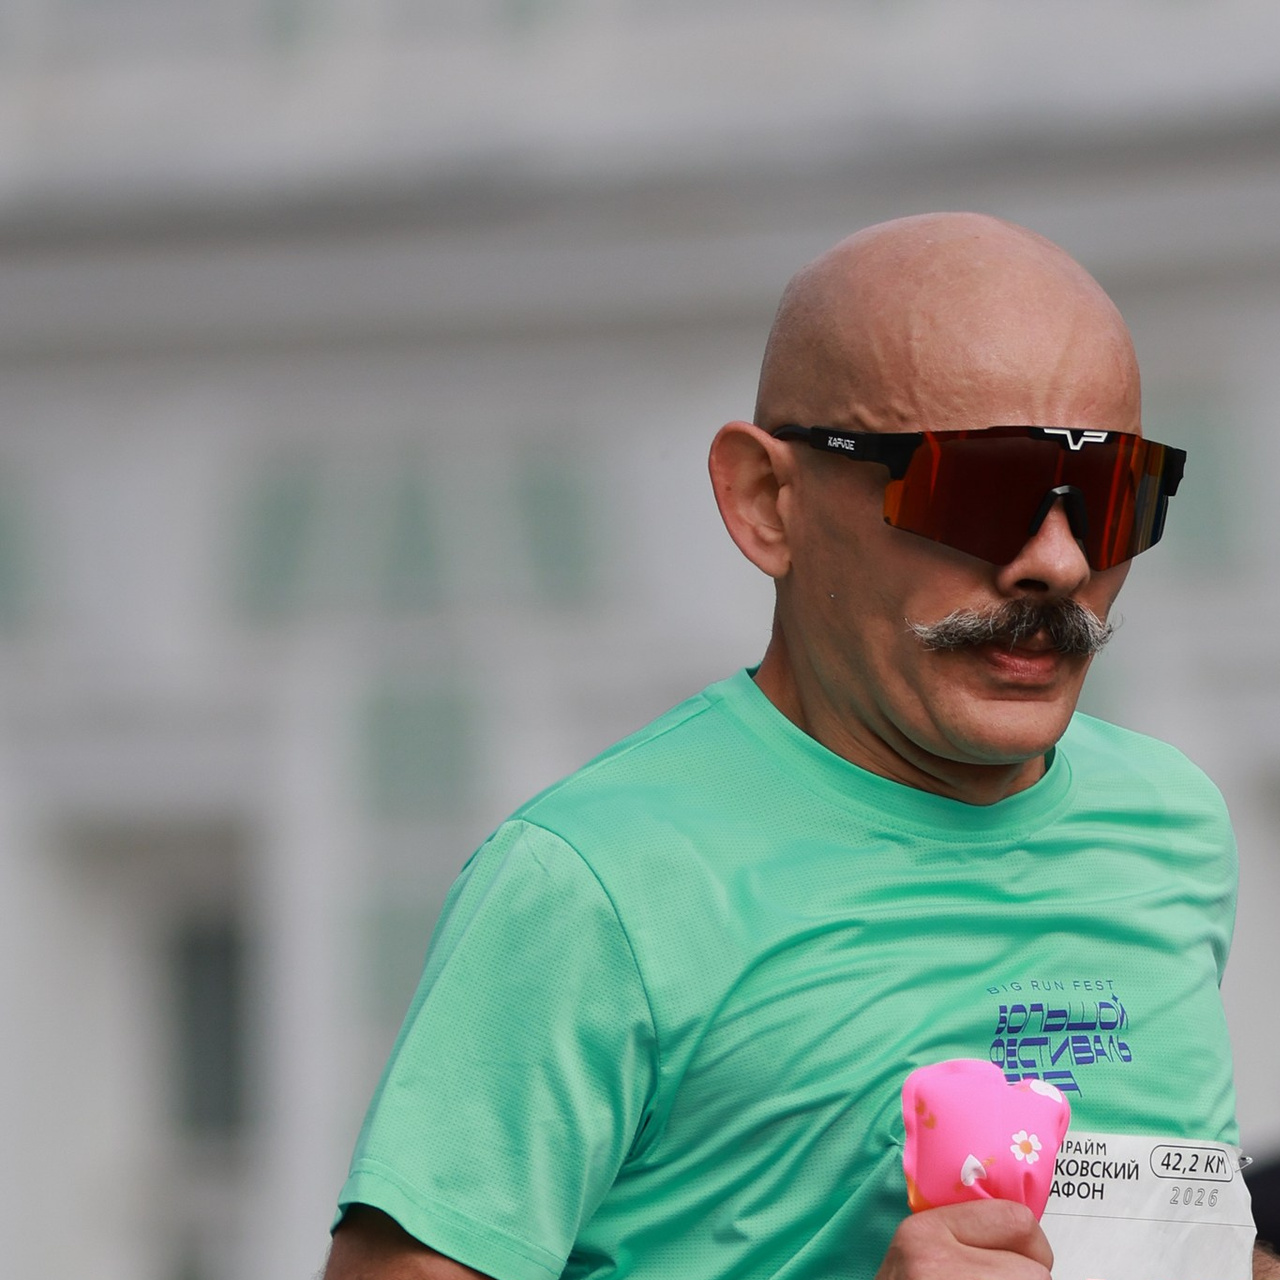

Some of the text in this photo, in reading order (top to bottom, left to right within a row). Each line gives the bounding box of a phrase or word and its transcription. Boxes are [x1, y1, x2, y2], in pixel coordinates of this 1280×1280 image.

[987, 980, 1114, 995] BIG RUN FEST
[989, 1035, 1132, 1069] ФЕСТИВАЛЬ
[1054, 1159, 1140, 1181] КОВСКИЙ
[1161, 1152, 1227, 1174] 42,2 КМ
[1049, 1181, 1104, 1200] АФОН
[1170, 1186, 1219, 1207] 2026
